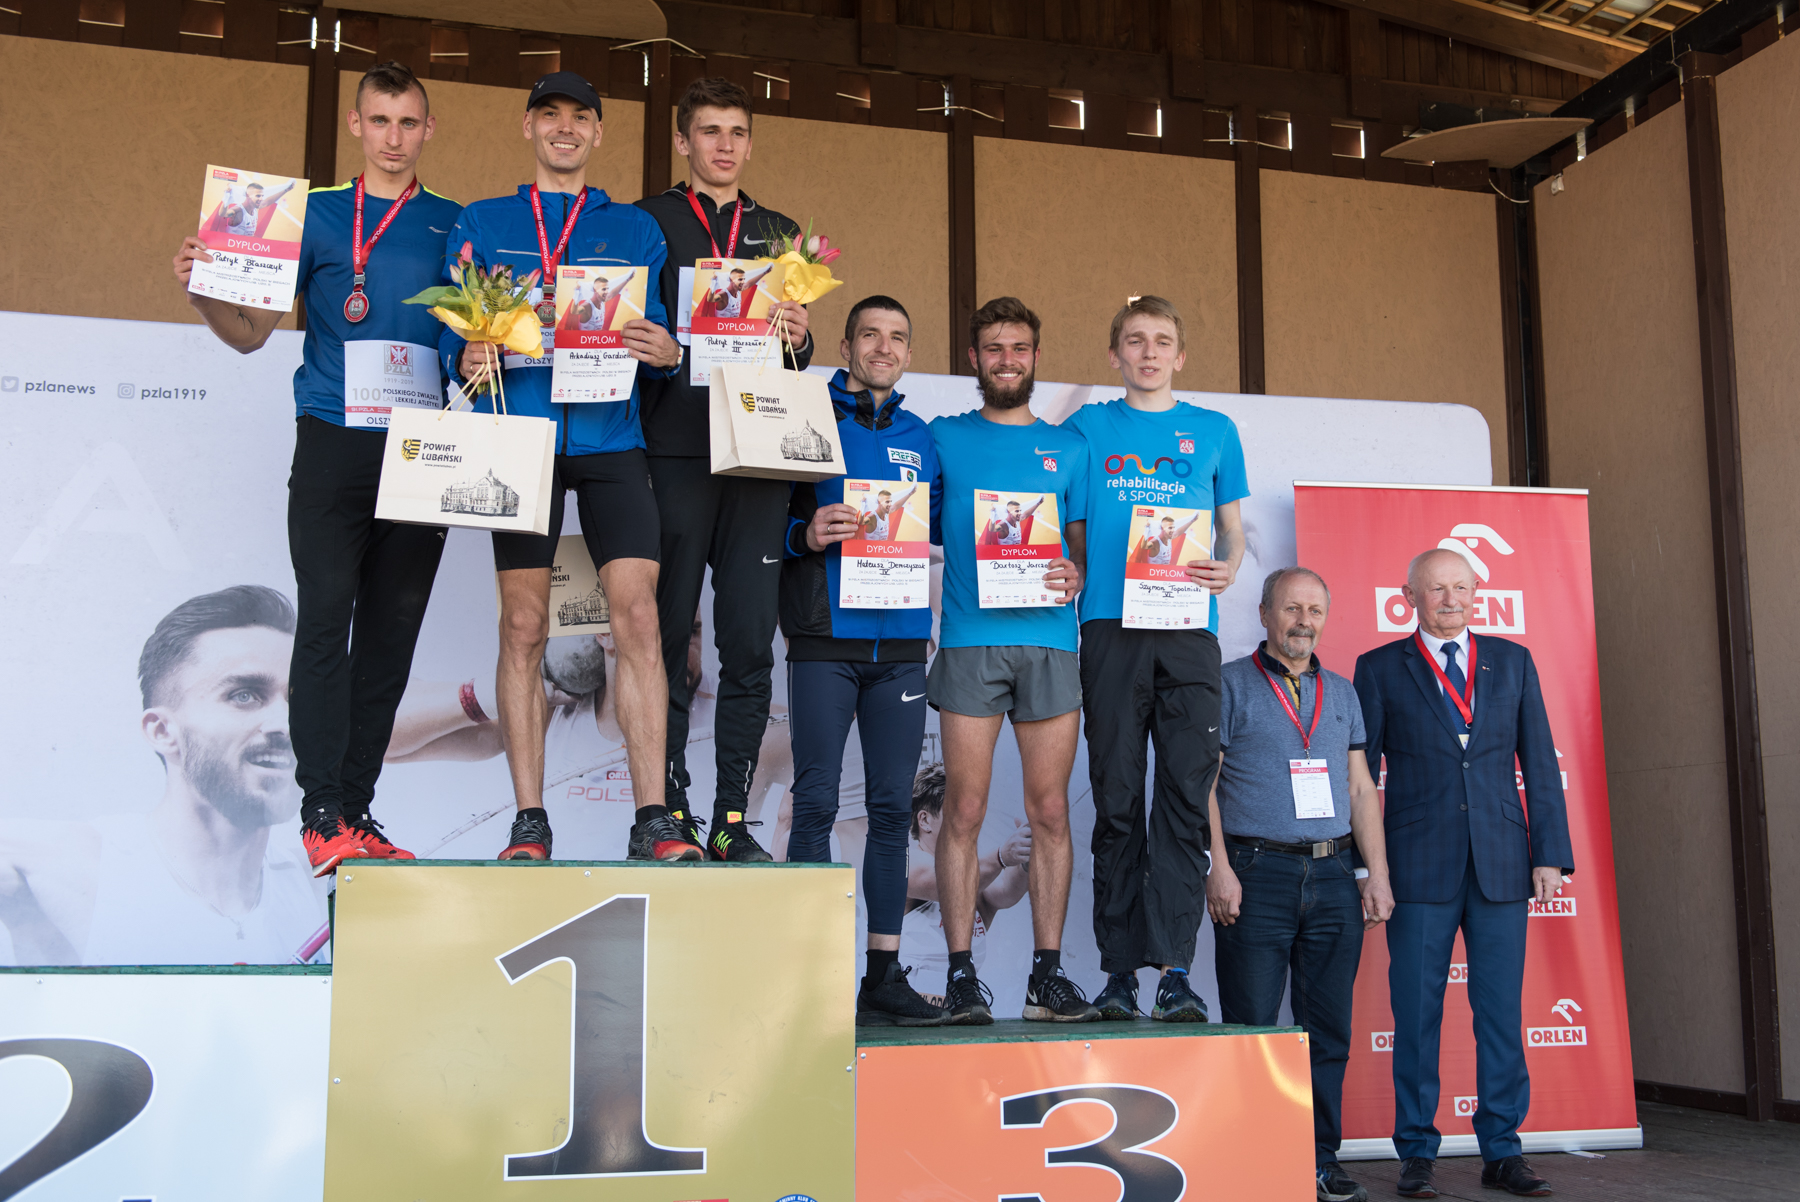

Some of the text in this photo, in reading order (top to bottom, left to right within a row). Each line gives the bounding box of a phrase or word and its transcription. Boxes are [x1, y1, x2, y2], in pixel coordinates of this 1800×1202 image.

[227, 238, 271, 253] DYPLOM
[555, 234, 567, 253] POLSKI
[213, 252, 239, 266] Patryk
[717, 322, 755, 332] DYPLOM
[580, 335, 616, 344] DYPLOM
[524, 357, 552, 365] OLSZY
[569, 351, 600, 360] Arkadiusz
[386, 365, 412, 375] PZLA
[24, 380, 96, 394] pzlanews
[141, 387, 207, 400] pzla1919
[352, 388, 381, 401] 100
[383, 388, 439, 401] POLSKIEGO ZWIĄZKU
[395, 397, 417, 405] LEKKIEJ
[418, 400, 440, 408] ATLETYKI
[756, 396, 780, 405] POWIAT
[757, 405, 788, 415] LUBAŃSKI
[423, 442, 457, 452] POWIAT
[421, 452, 462, 463] LUBAŃSKI
[1106, 476, 1186, 495] rehabilitacja
[1117, 490, 1173, 505] & SPORT
[866, 545, 903, 554] DYPLOM
[1001, 548, 1037, 556] DYPLOM
[857, 559, 884, 568] Mateusz
[552, 573, 570, 582] ŃSKI
[879, 568, 890, 576] IV
[1149, 568, 1185, 578] DYPLOM
[1384, 594, 1515, 627] OEN
[566, 785, 634, 803] POLS
[495, 893, 706, 1178] 1
[1530, 1029, 1583, 1044] ORLEN
[998, 1082, 1188, 1202] 3
